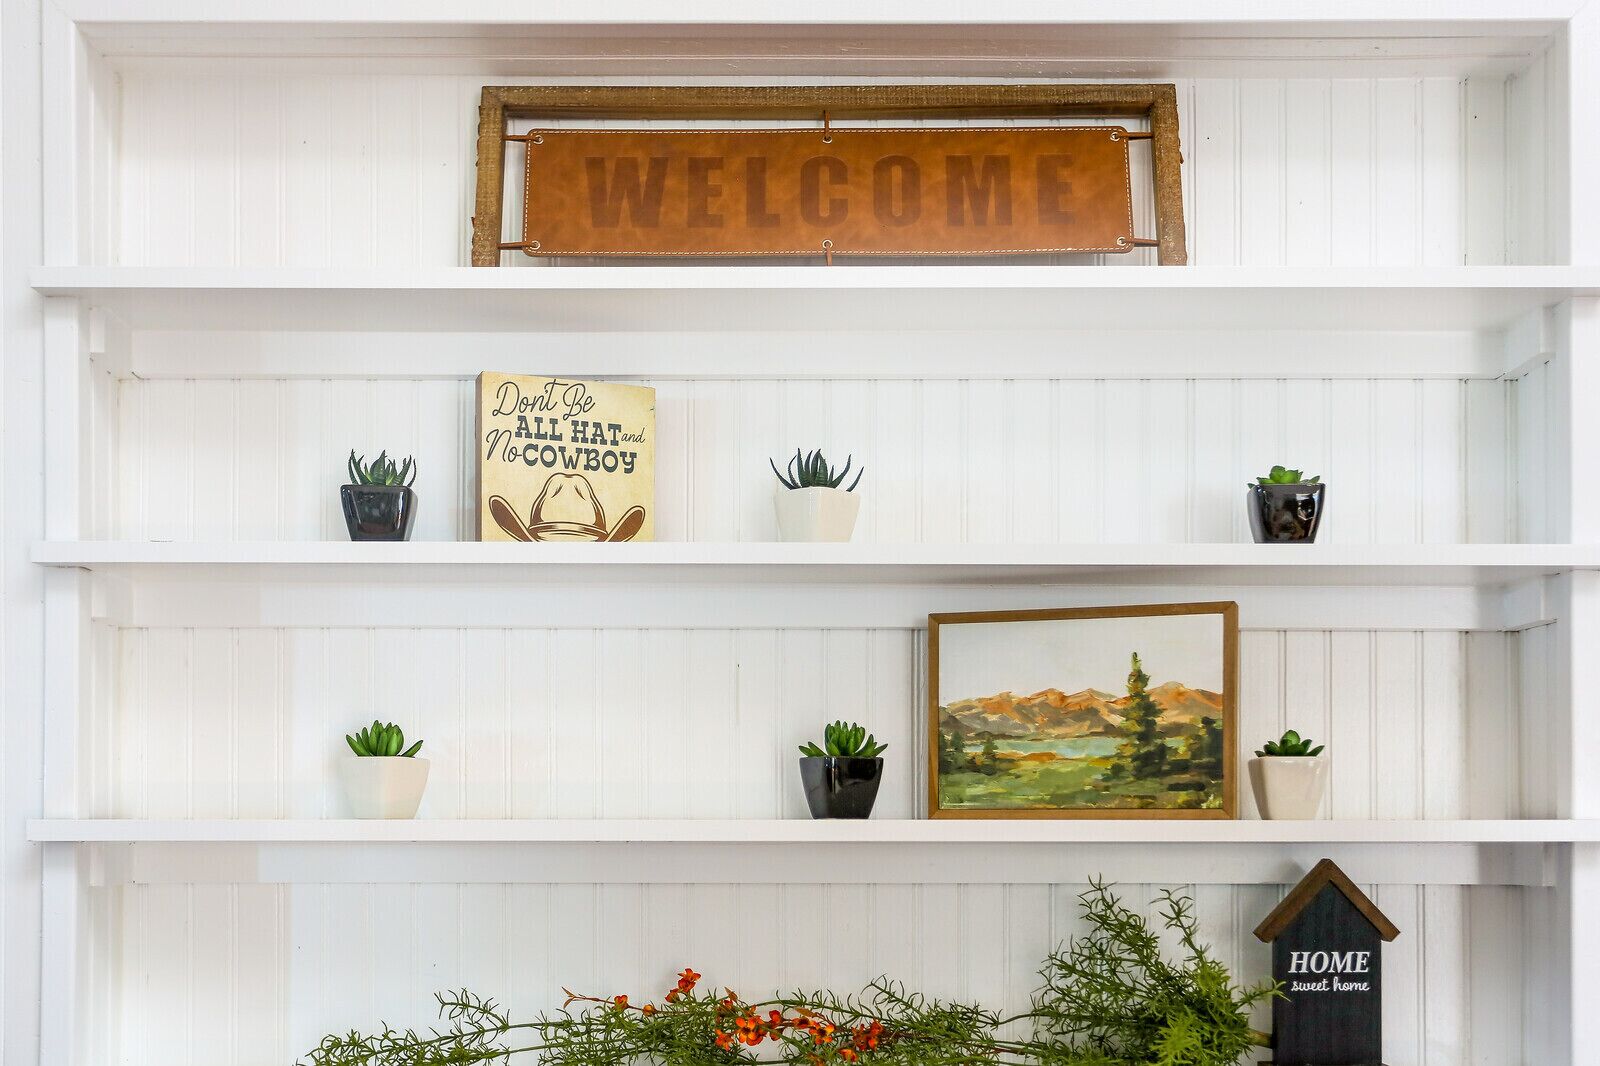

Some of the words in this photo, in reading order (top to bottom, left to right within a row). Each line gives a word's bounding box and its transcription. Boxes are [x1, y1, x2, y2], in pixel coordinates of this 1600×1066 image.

[584, 153, 1076, 228] WELCOME
[492, 379, 568, 416] Don't
[562, 383, 595, 420] Be
[515, 415, 563, 441] ALL
[571, 420, 622, 446] HAT
[621, 427, 645, 443] and
[486, 429, 522, 462] No
[522, 443, 637, 473] COWBOY
[1288, 951, 1370, 973] HOME
[1291, 978, 1330, 991] sweet
[1333, 976, 1370, 991] home
